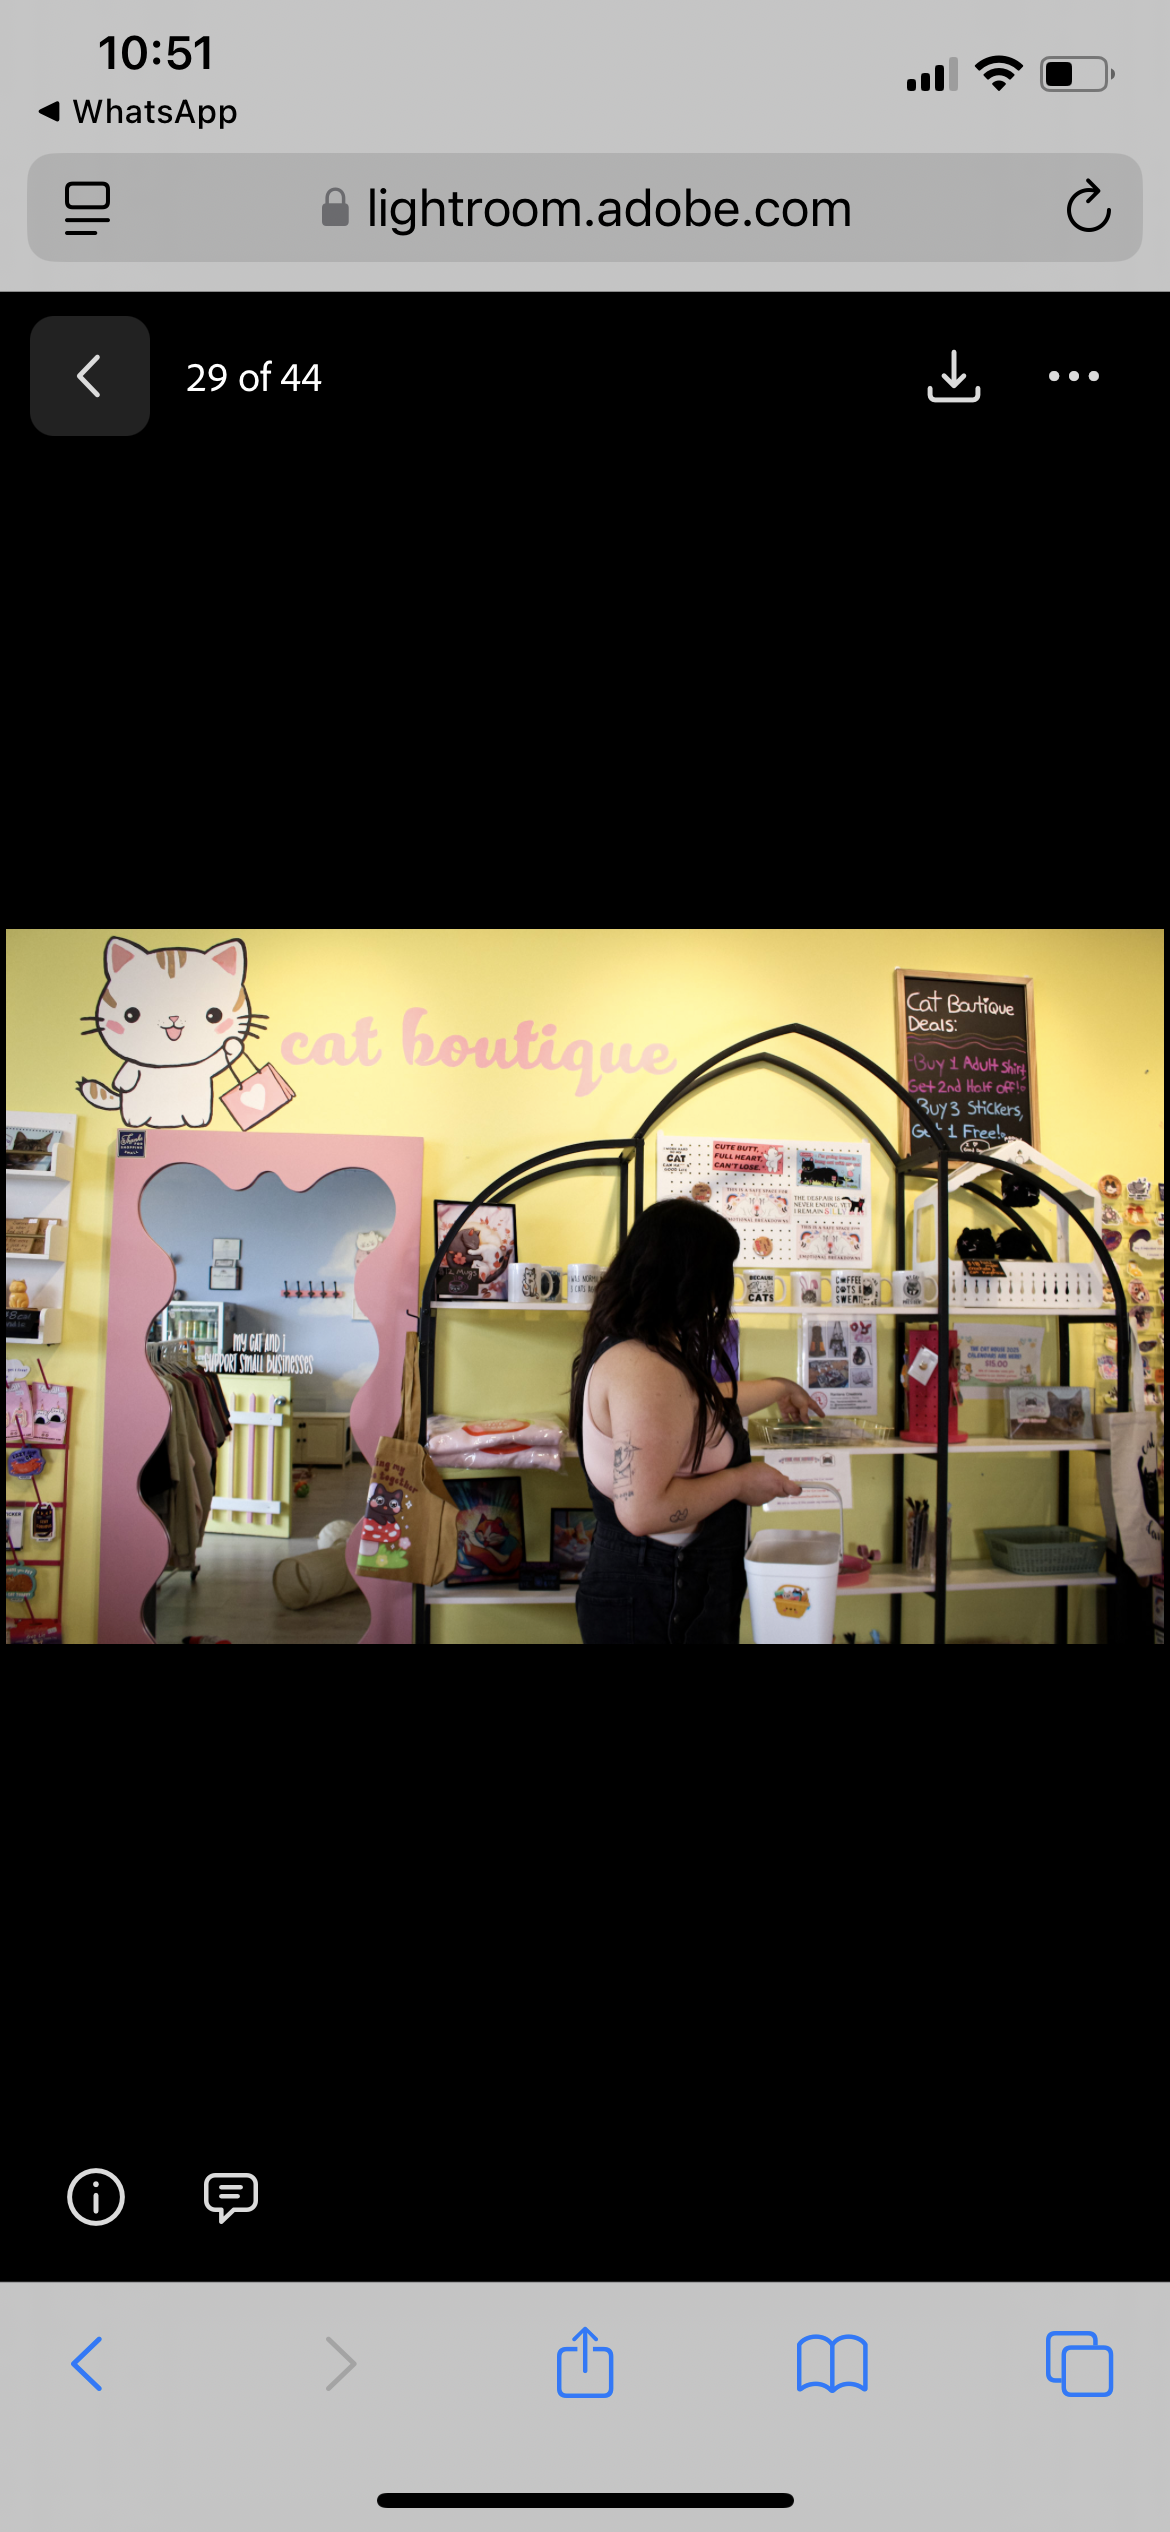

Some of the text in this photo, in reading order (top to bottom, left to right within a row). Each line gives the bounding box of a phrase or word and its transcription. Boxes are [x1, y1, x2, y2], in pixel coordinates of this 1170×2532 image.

[99, 34, 210, 71] 10:51
[72, 98, 237, 130] WhatsApp
[369, 187, 851, 237] lightroom.adobe.com
[186, 359, 323, 392] 29 of 44
[907, 990, 942, 1012] Cat
[908, 1016, 957, 1032] Deals:
[281, 1007, 677, 1097] cat boutique
[950, 1057, 958, 1070] 1
[963, 1056, 999, 1072] Adult
[908, 1079, 936, 1093] Get
[938, 1078, 961, 1093] 2nd
[967, 1079, 993, 1093] Half
[950, 1102, 960, 1116] 3
[948, 1124, 957, 1138] 1
[667, 1154, 686, 1162] CAT
[456, 1269, 477, 1280] Mugs
[748, 1294, 774, 1302] CATS
[985, 1360, 1008, 1368] $15.00
[380, 1471, 418, 1493] together
